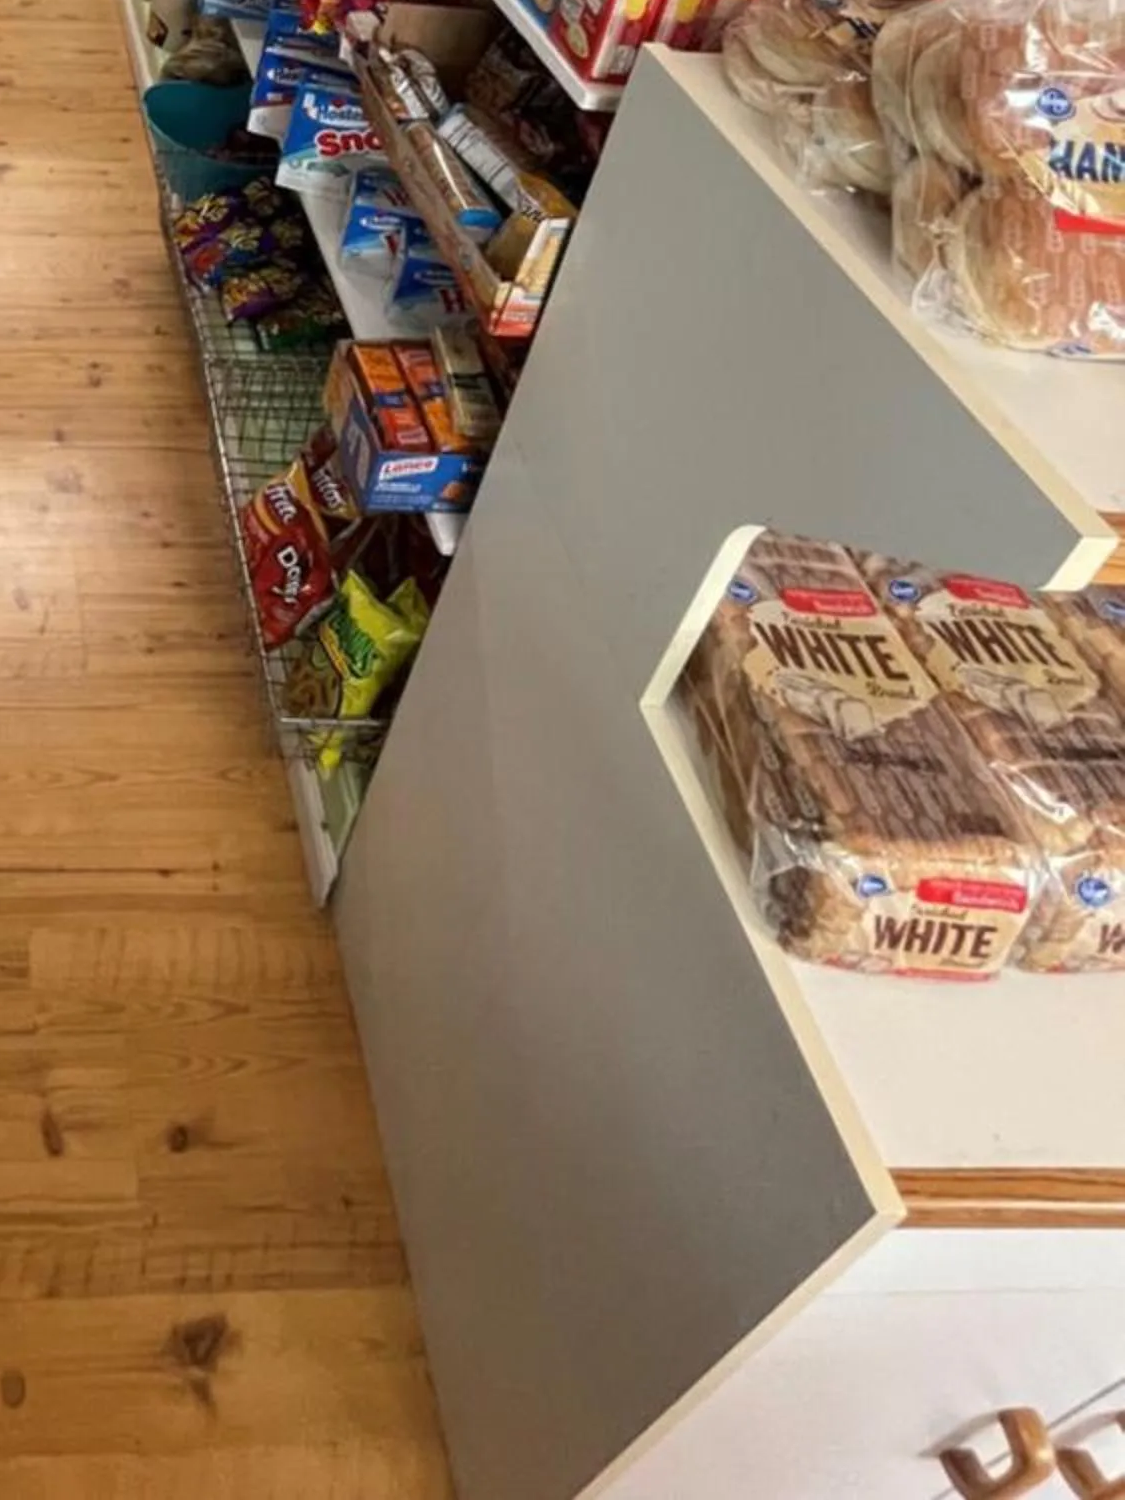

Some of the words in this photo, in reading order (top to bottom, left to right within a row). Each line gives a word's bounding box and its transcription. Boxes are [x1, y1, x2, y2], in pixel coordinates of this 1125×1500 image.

[383, 459, 434, 476] Lance
[752, 620, 911, 682] WHITE
[925, 618, 1076, 672] WHITE
[873, 914, 999, 960] WHITE
